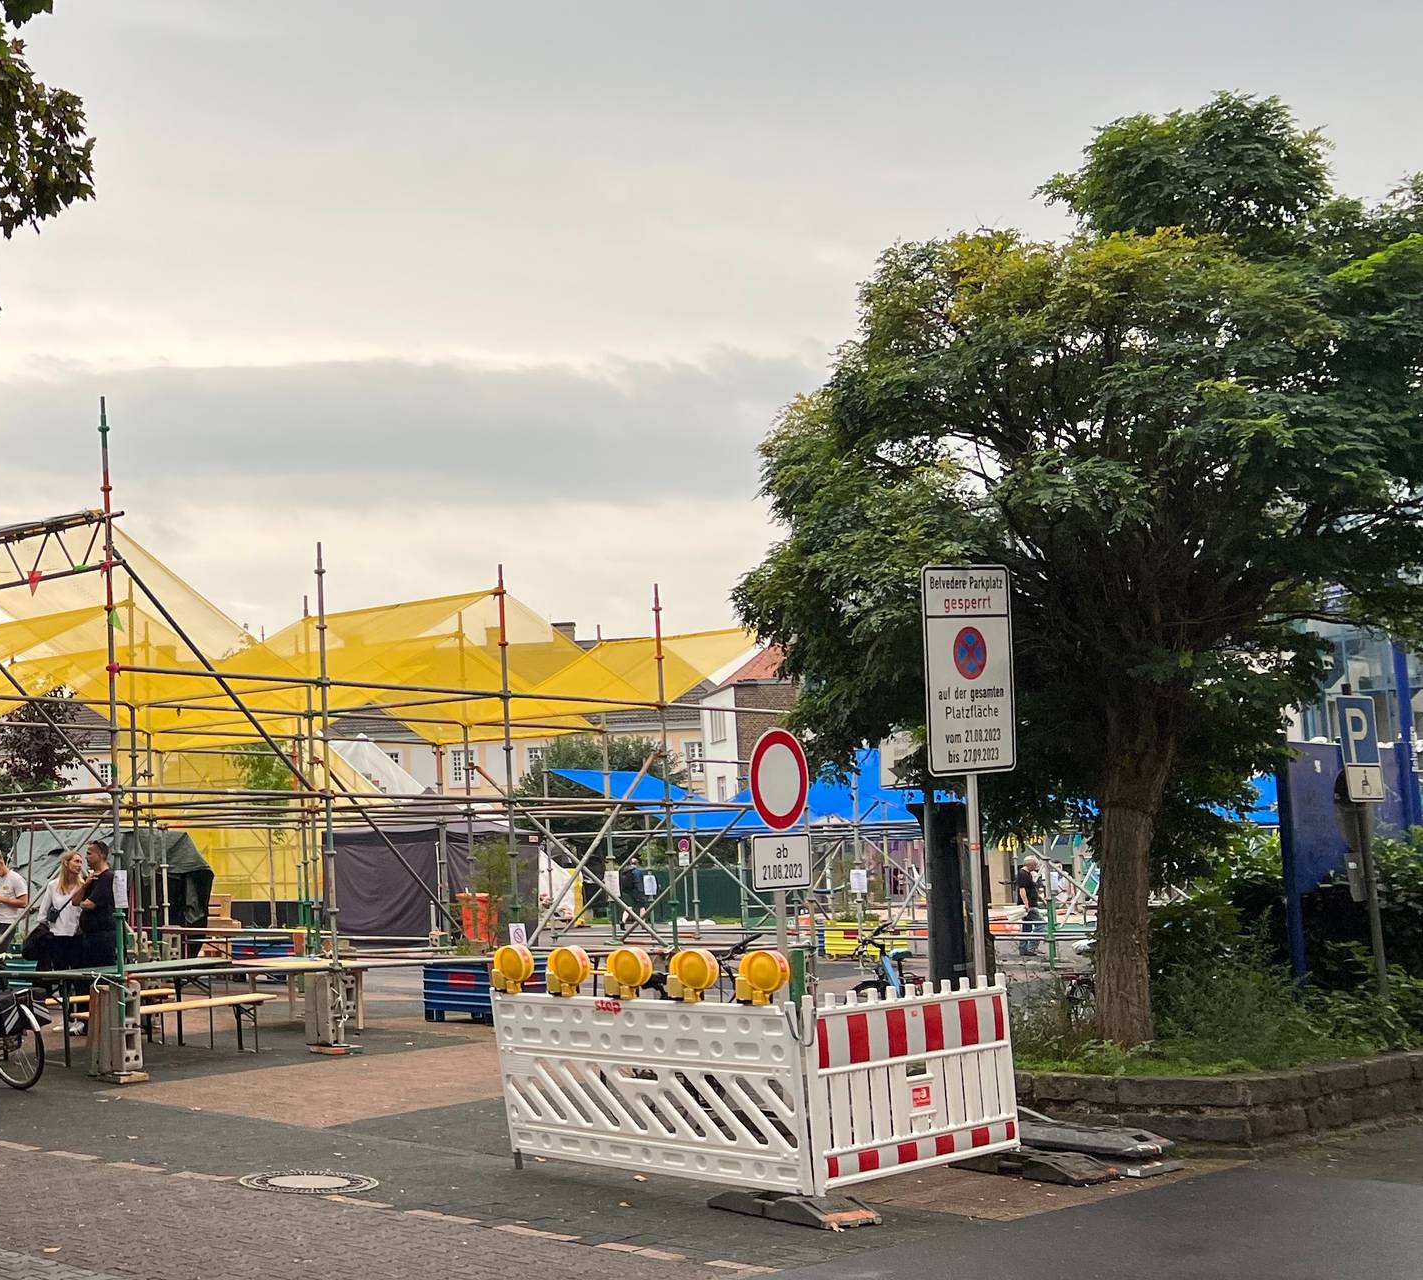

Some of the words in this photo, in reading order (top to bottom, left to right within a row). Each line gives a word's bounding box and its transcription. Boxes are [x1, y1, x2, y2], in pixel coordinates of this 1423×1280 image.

[929, 575, 967, 590] Belvedere
[969, 575, 1004, 592] Parkplatz
[944, 595, 992, 613] gesperrt
[938, 686, 951, 700] auf
[954, 686, 967, 700] der
[970, 685, 1005, 702] gesamten
[945, 703, 999, 720] Platzfläche
[945, 733, 962, 744] vom
[964, 727, 1001, 743] 21.08.2023
[1344, 707, 1368, 764] P
[948, 749, 960, 764] bis
[776, 843, 789, 859] ab
[762, 863, 803, 881] 21.08.2023
